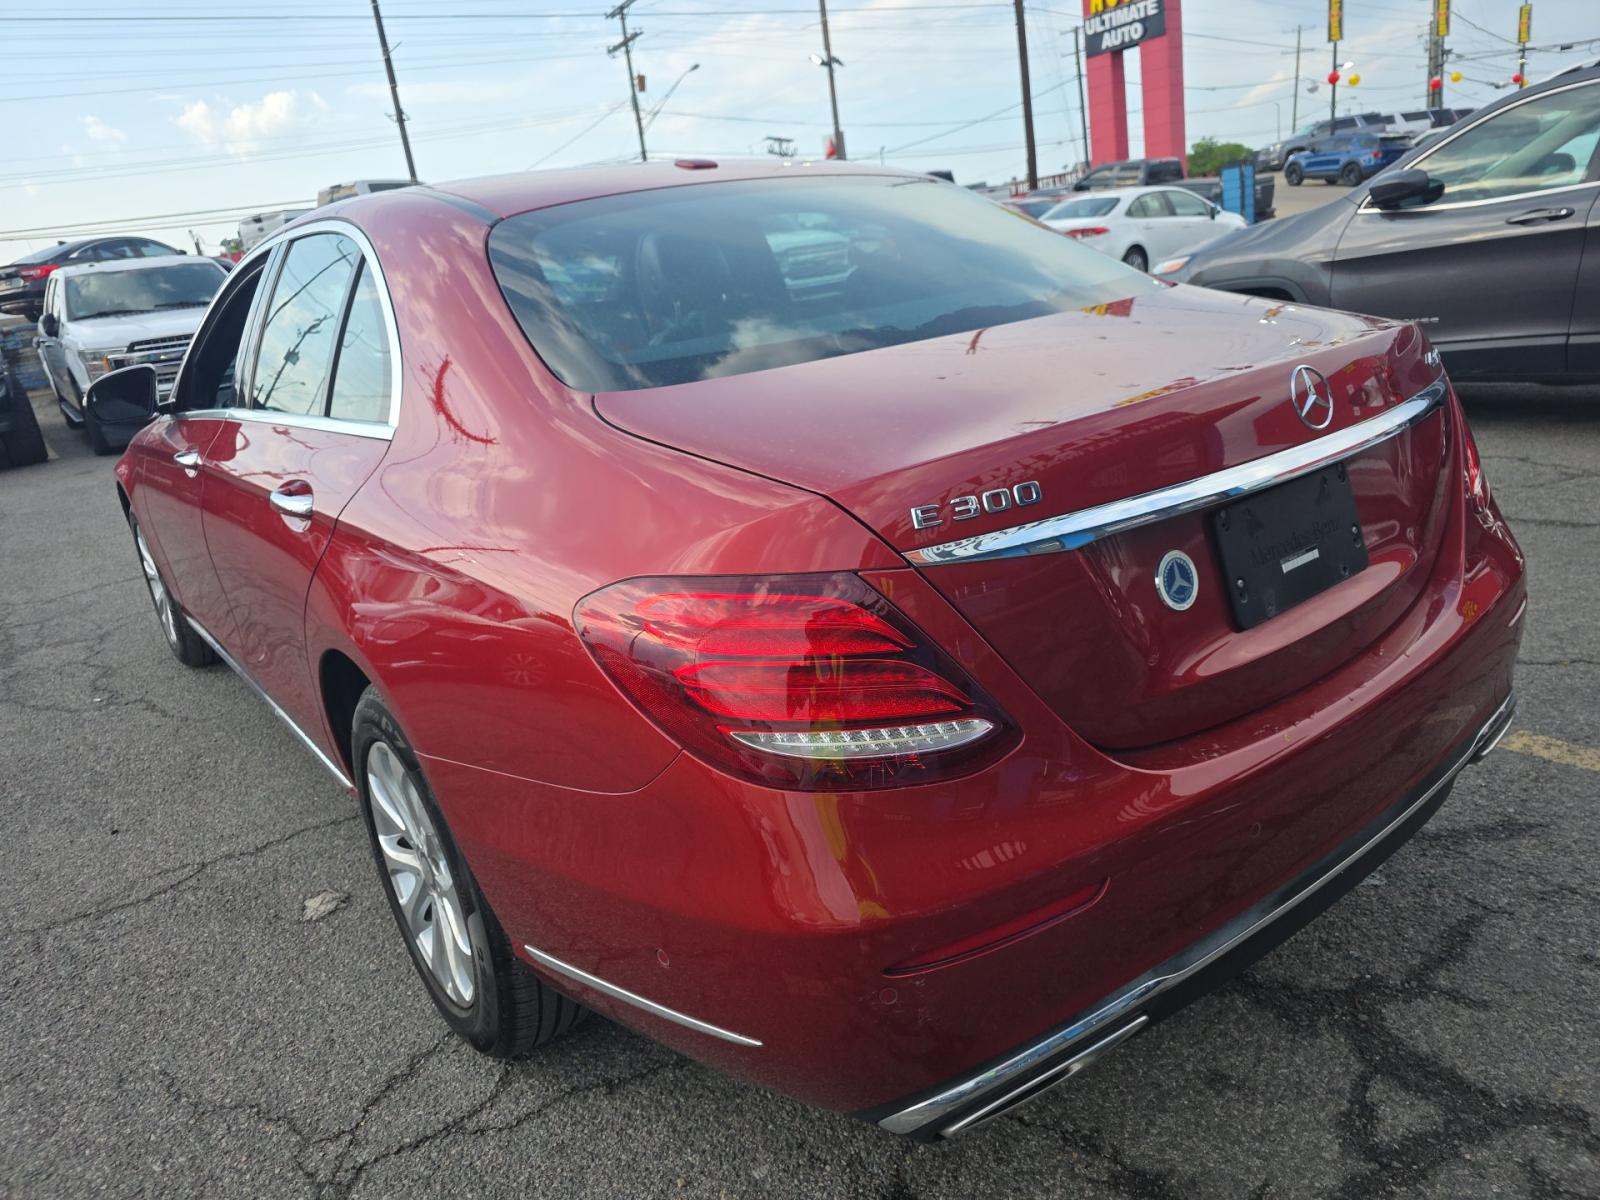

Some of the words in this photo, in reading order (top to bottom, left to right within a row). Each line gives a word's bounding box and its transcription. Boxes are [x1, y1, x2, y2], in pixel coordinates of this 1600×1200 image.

[1085, 1, 1160, 36] ULTIMATE
[1101, 22, 1144, 50] AUTO
[910, 504, 944, 530] E
[949, 480, 1042, 521] 300
